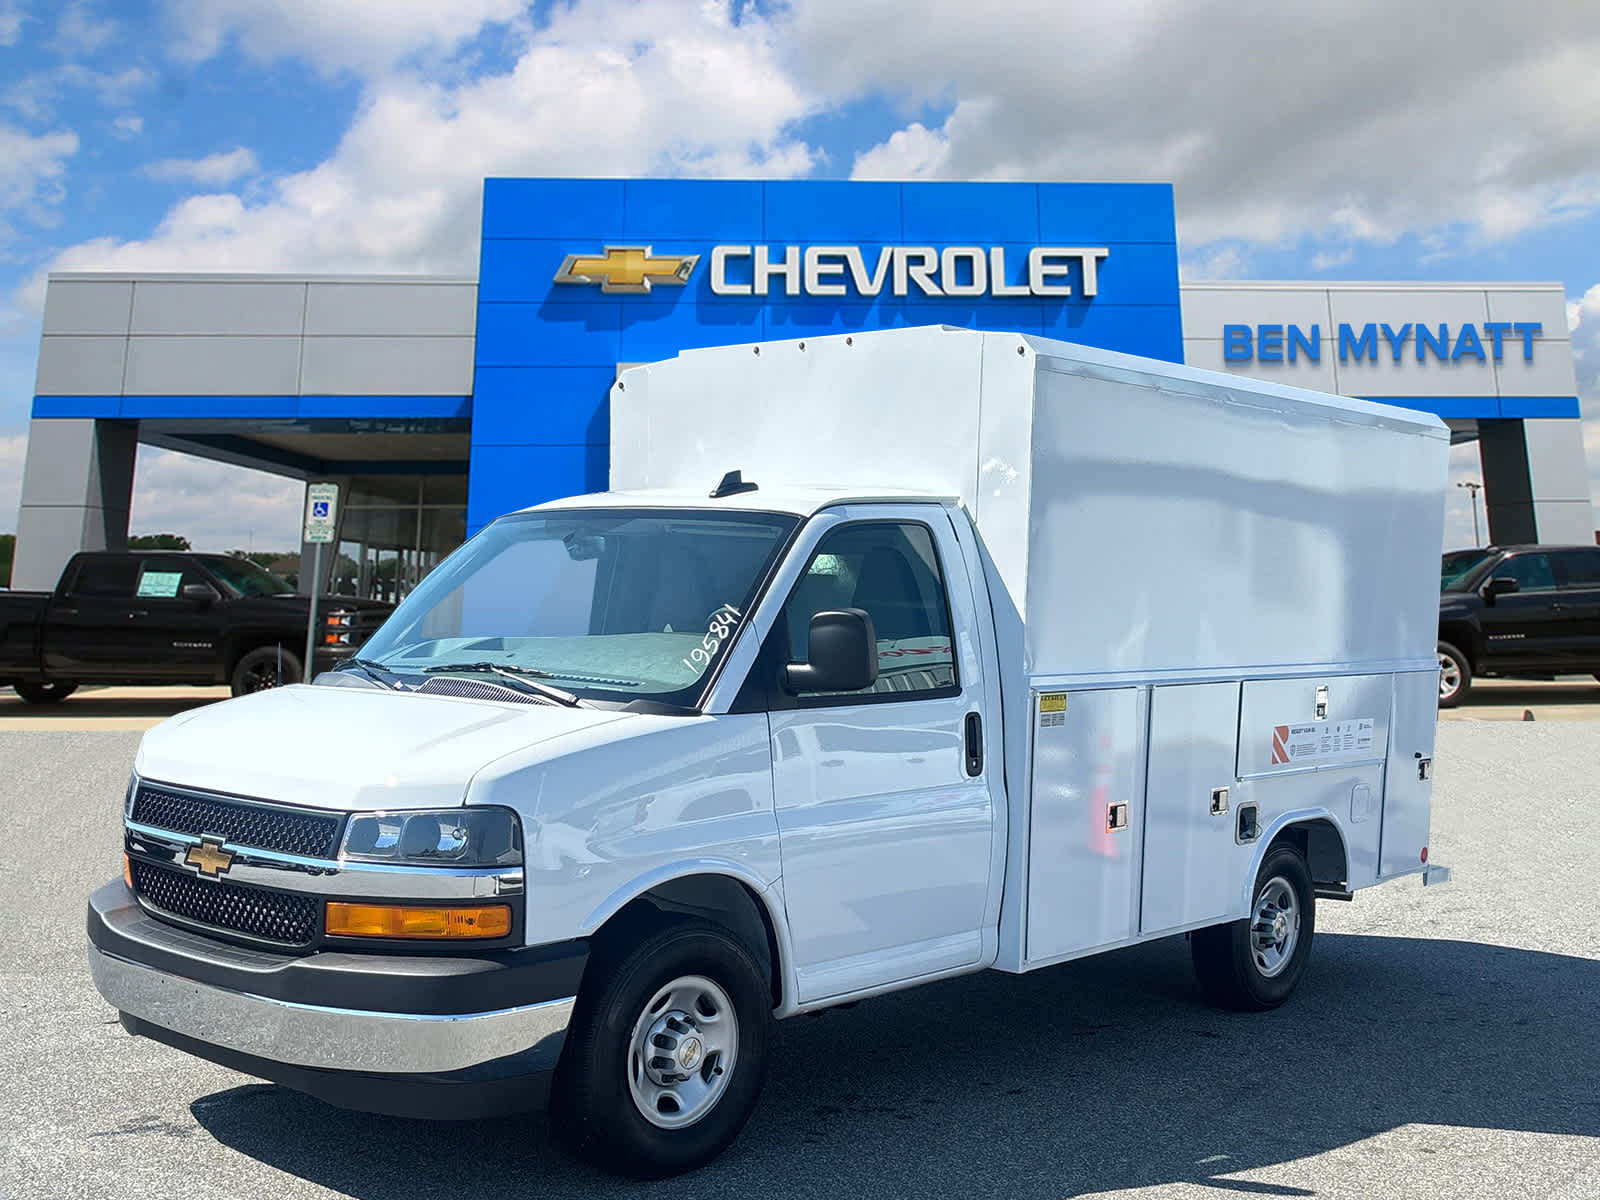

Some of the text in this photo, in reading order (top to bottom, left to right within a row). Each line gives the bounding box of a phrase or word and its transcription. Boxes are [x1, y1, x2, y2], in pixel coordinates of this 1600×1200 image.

[710, 245, 1110, 296] CHEVROLET
[1223, 322, 1543, 362] BEN MYNATT
[682, 603, 742, 675] 195841
